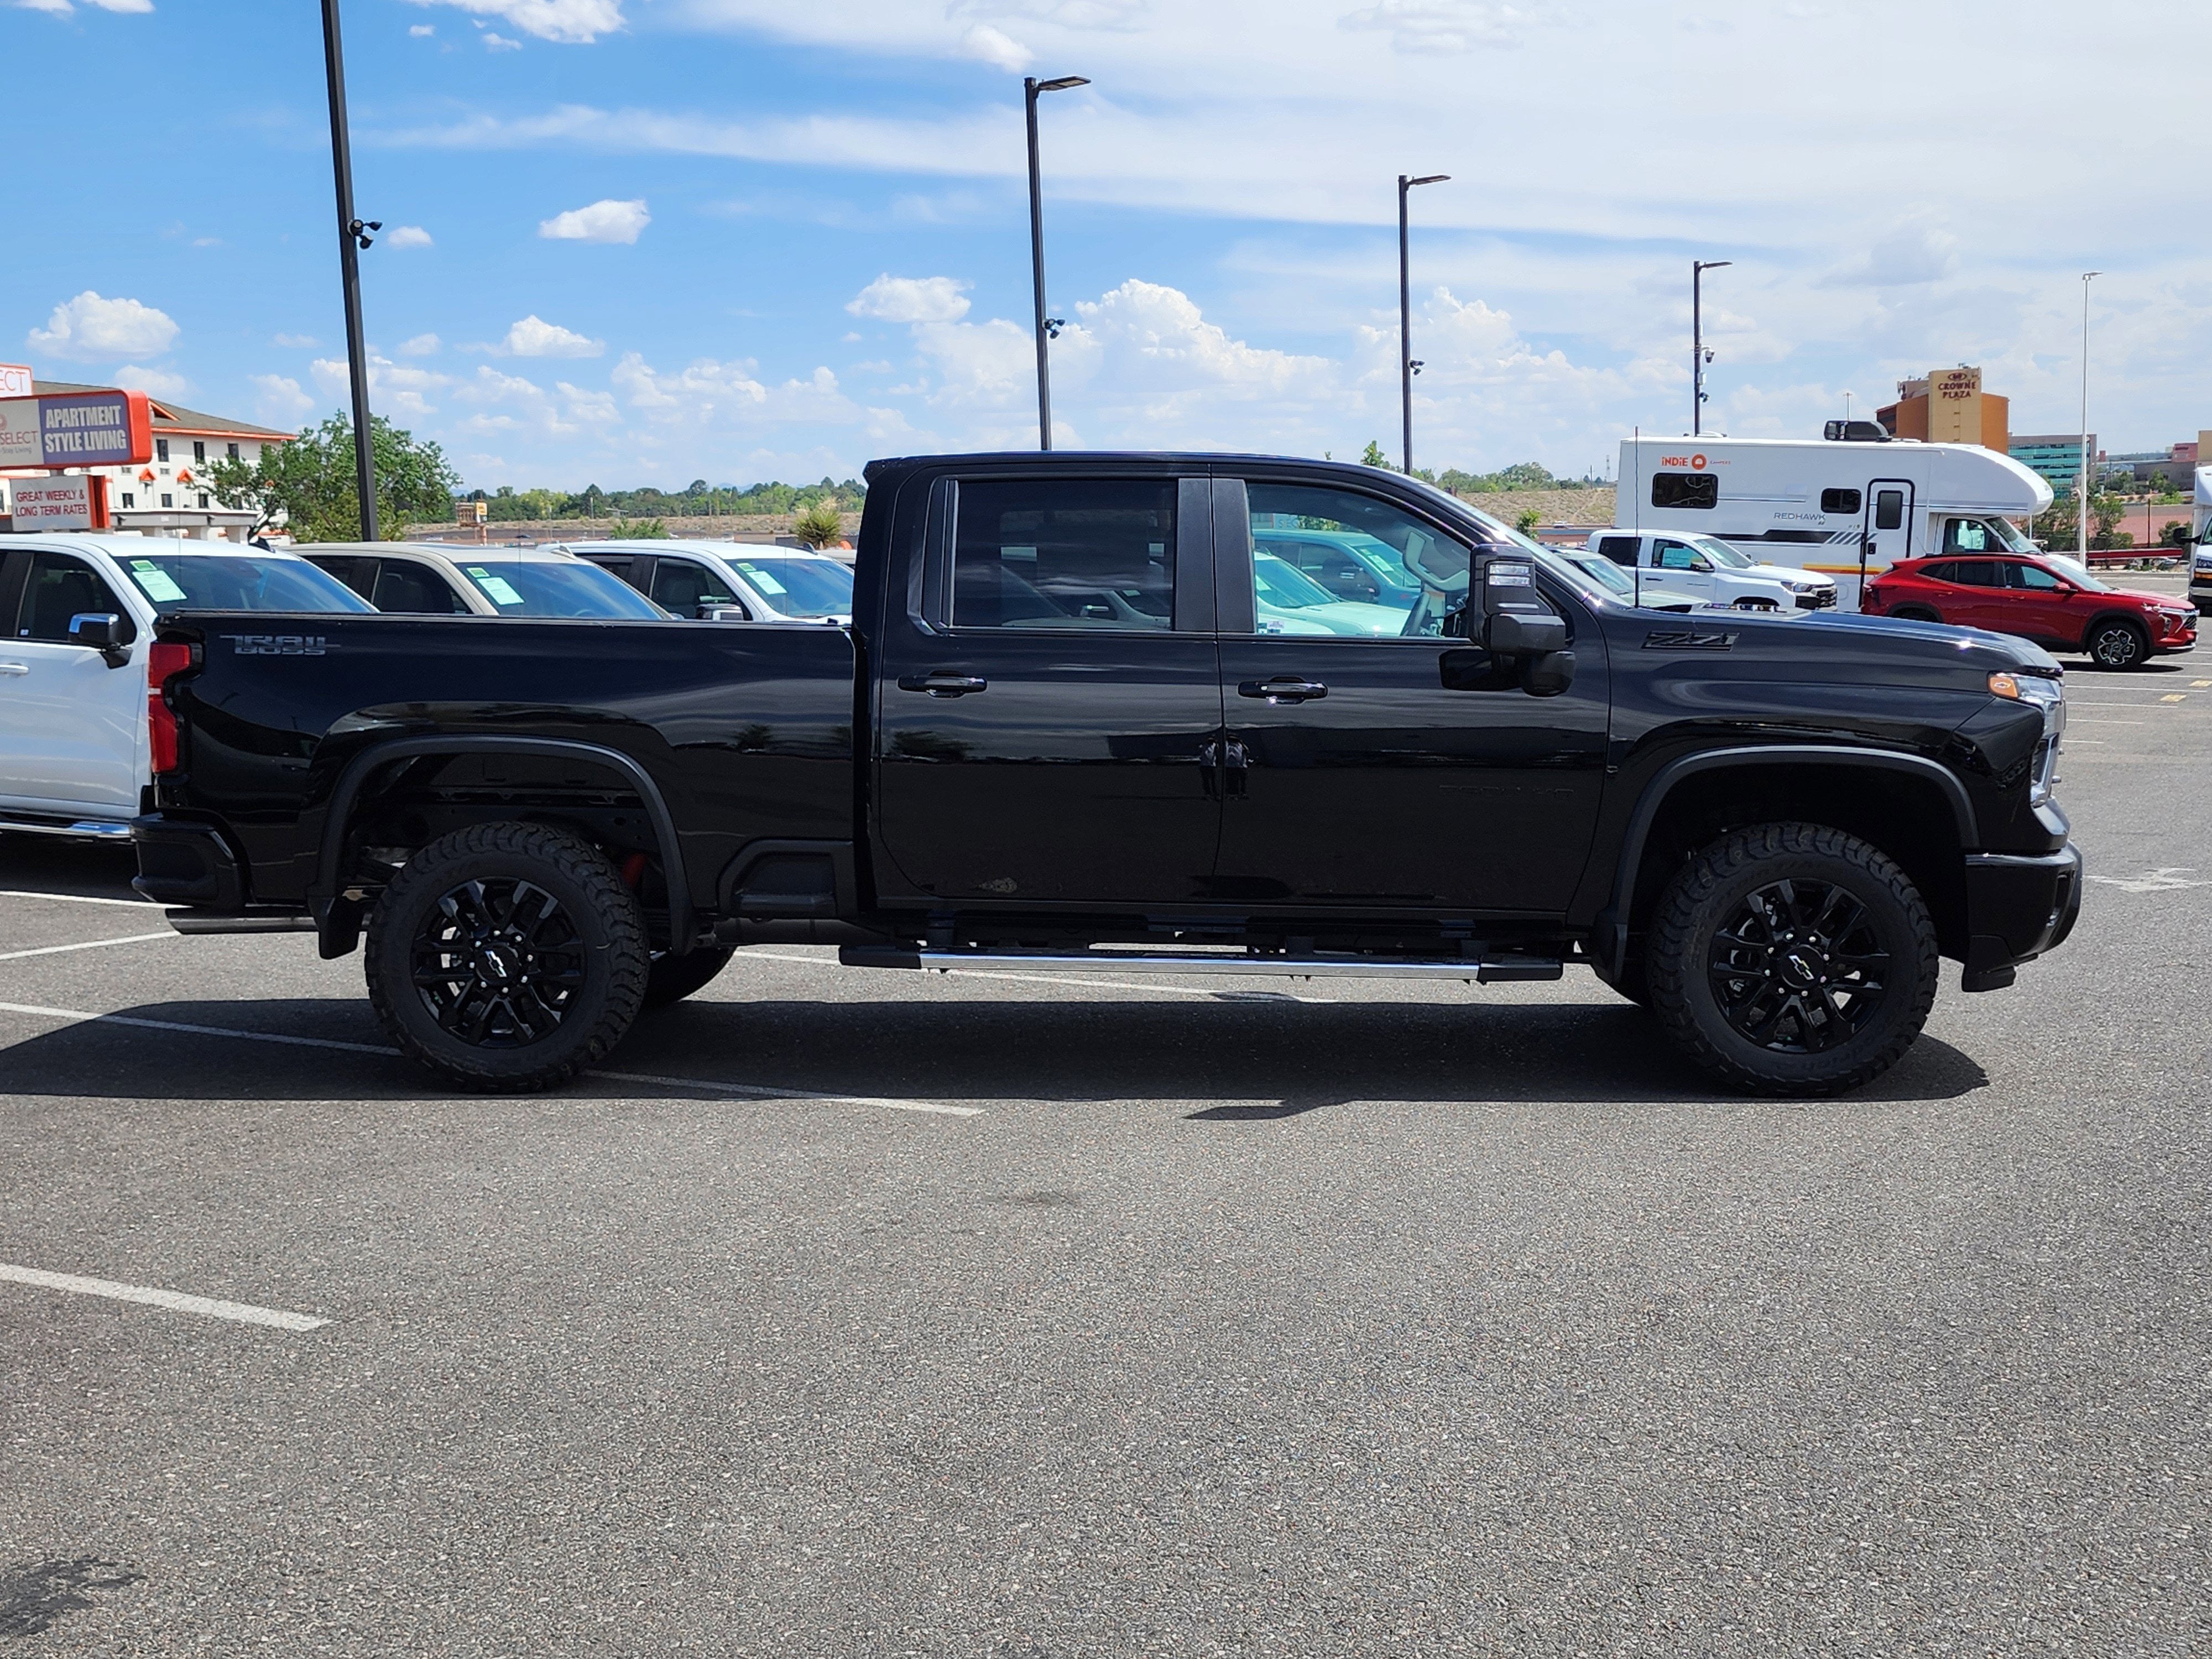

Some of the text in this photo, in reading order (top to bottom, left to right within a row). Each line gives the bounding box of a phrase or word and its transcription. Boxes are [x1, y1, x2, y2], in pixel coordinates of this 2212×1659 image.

[1938, 380, 1976, 390] CROWNE
[1943, 390, 1971, 399] PLAZA
[46, 405, 121, 429] APARTMENT
[0, 431, 38, 445] SELECT
[44, 429, 127, 453] STYLE LIVING
[16, 489, 85, 502] GREAT WEEKLY &
[15, 504, 87, 517] LONG TERM RATES
[220, 635, 325, 648] TRAIL
[1640, 630, 1740, 651] Z71
[234, 646, 326, 655] BOSS
